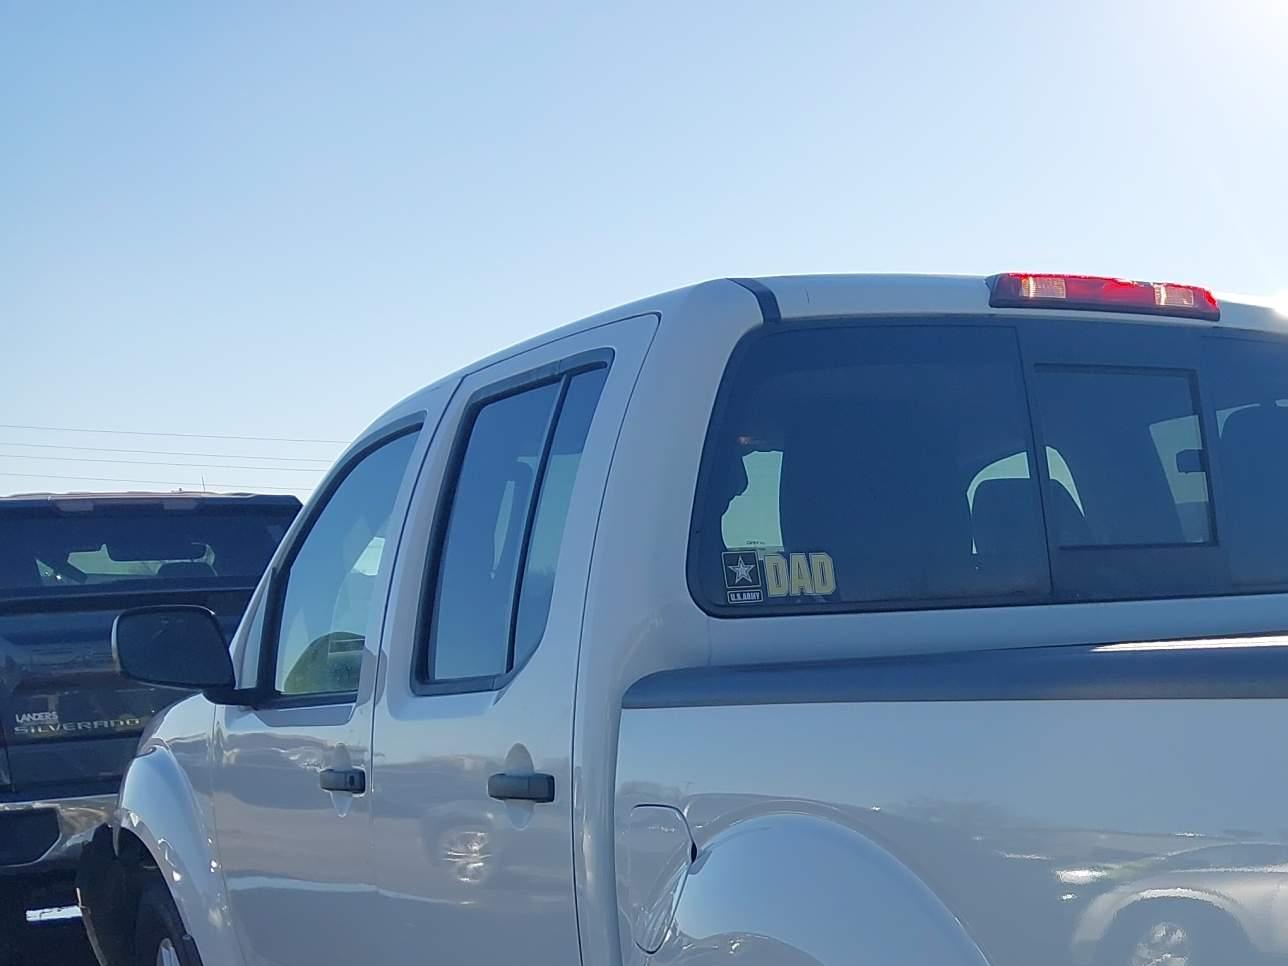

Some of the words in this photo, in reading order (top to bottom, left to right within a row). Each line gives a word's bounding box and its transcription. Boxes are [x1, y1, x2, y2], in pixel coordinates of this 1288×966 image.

[764, 552, 836, 598] DAD
[15, 711, 58, 723] LANDERS
[14, 718, 139, 735] SILVERADO
